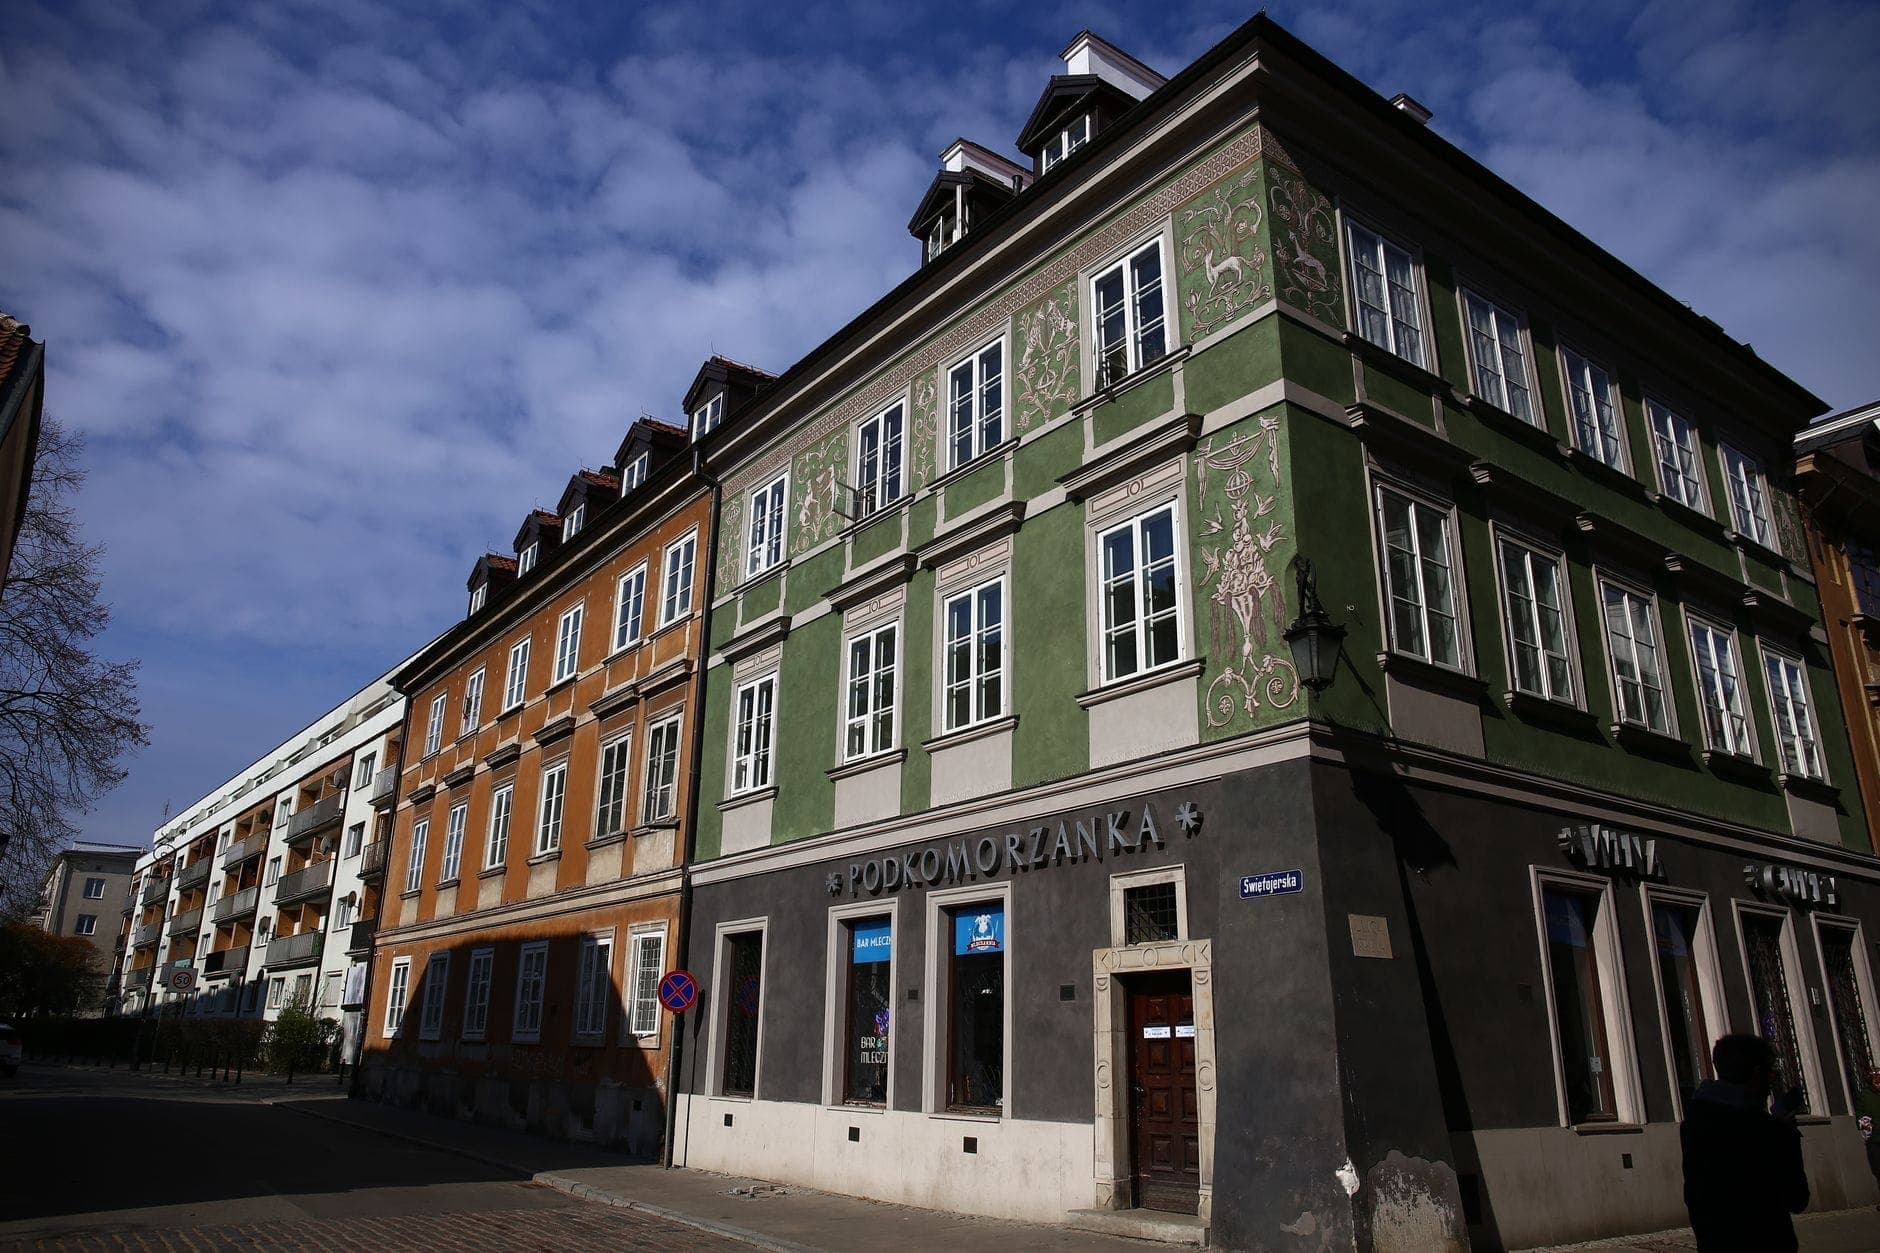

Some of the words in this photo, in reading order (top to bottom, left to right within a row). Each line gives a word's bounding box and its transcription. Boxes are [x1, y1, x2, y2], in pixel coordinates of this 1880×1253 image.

[848, 802, 1162, 893] PODKOMORZANKA
[856, 937, 869, 948] BAR
[175, 976, 190, 985] 50
[860, 1036, 876, 1049] BAR
